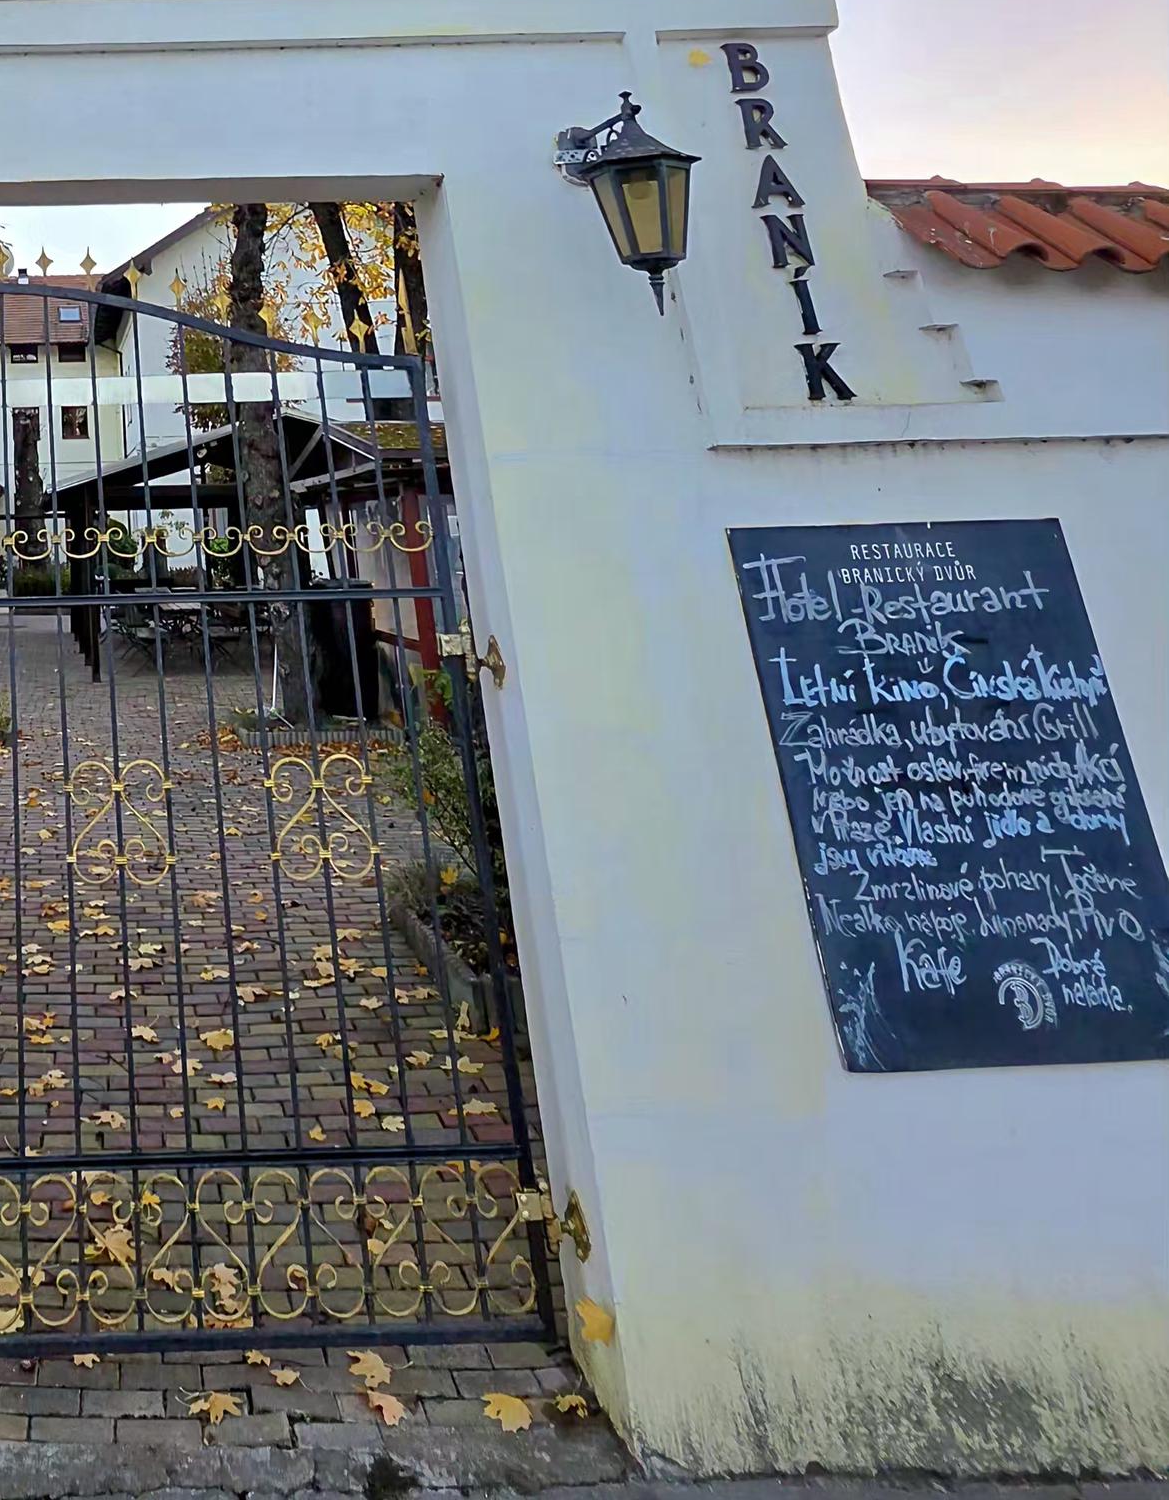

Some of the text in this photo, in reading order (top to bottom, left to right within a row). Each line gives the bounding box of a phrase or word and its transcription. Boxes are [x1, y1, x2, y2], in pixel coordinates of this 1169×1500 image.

[850, 541, 956, 560] RESTAURACE
[840, 559, 977, 585] BRANICKÝ DVŮR
[1032, 702, 1100, 740] Grill
